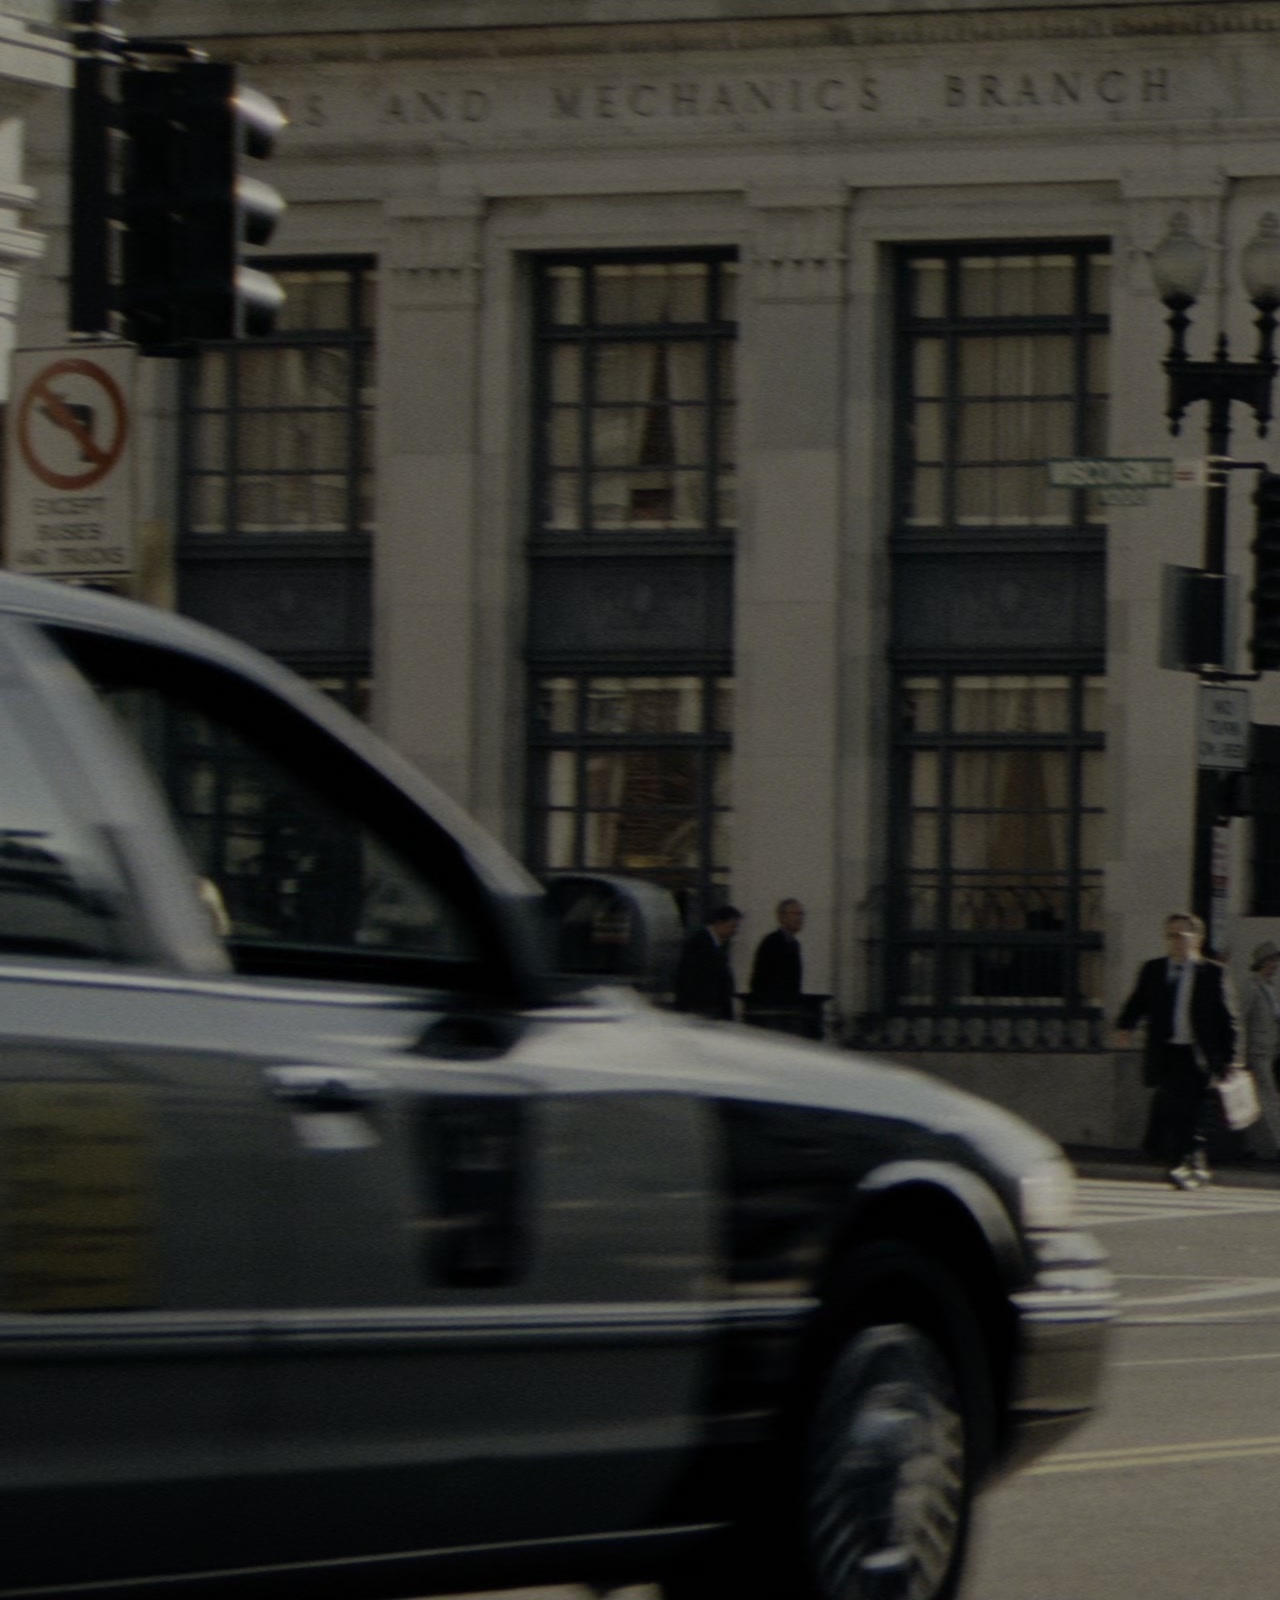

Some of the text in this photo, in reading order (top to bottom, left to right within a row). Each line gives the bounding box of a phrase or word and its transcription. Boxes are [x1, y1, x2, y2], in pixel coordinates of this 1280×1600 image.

[379, 90, 489, 124] AND
[549, 77, 878, 120] MECHANICS
[944, 68, 1169, 109] BRANCH
